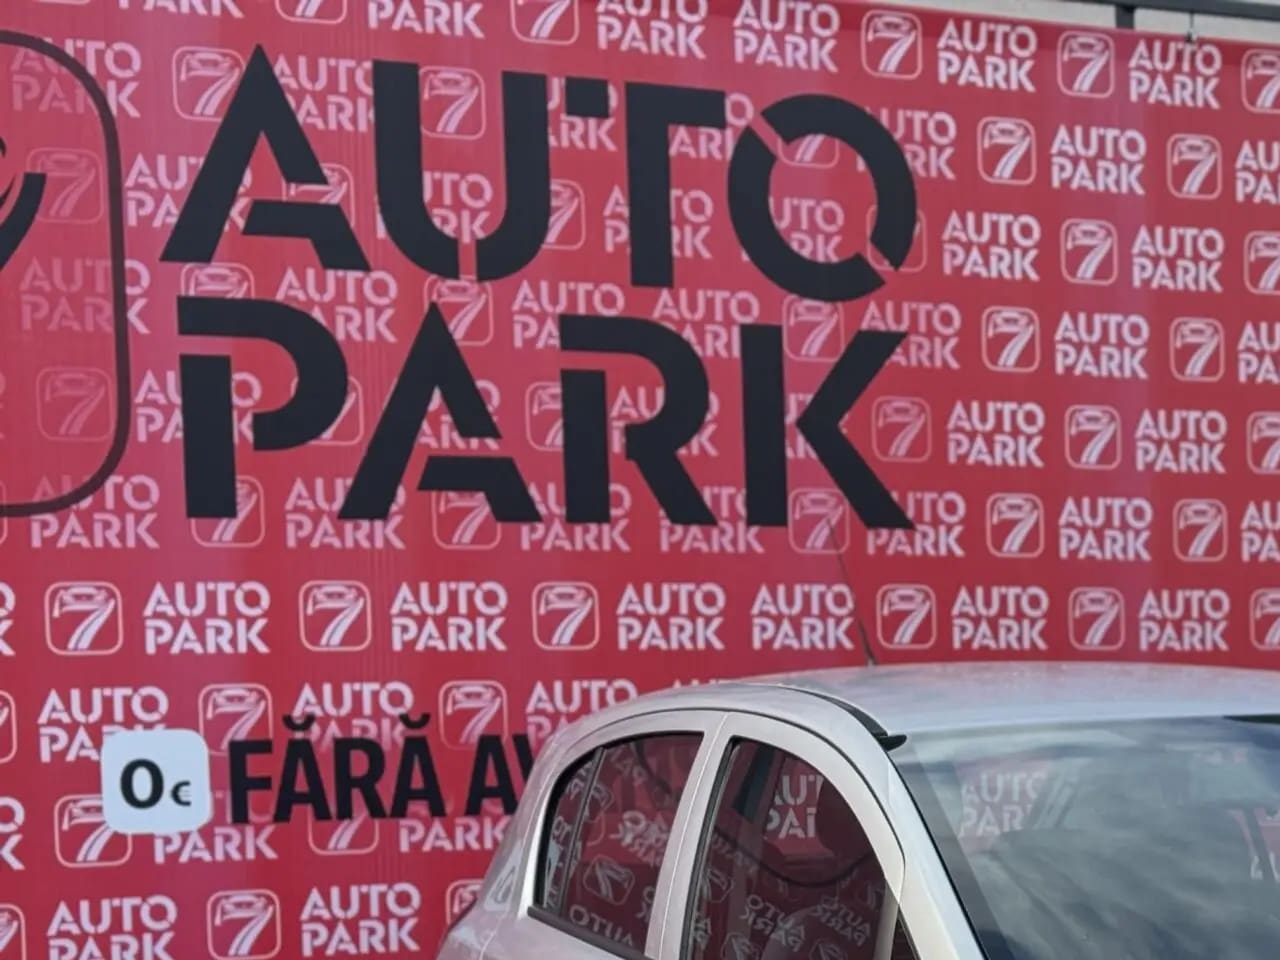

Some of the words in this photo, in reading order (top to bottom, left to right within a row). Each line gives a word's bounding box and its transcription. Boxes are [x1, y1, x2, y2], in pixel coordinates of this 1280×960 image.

[597, 15, 706, 60] PARK
[734, 0, 839, 38] AUTO
[937, 17, 1037, 58] AUTO
[734, 28, 837, 72] PARK
[1129, 40, 1221, 76] AUTO
[938, 50, 1035, 92] PARK
[1129, 70, 1219, 109] PARK
[1051, 125, 1146, 162] AUTO
[161, 44, 918, 303] AUTO
[1052, 155, 1145, 195] PARK
[943, 211, 1041, 247] AUTO
[1131, 226, 1224, 261] AUTO
[943, 243, 1038, 281] PARK
[1132, 255, 1222, 292] PARK
[275, 266, 398, 305] AUTO
[511, 280, 626, 317] AUTO
[652, 287, 760, 324] AUTO
[859, 300, 963, 336] AUTO
[1055, 312, 1150, 347] AUTO
[1055, 342, 1148, 379] PARK
[177, 296, 914, 530] PARK
[948, 401, 1045, 435] AUTO
[1135, 409, 1227, 441] AUTO
[948, 432, 1044, 467] PARK
[1136, 440, 1225, 473] PARK
[30, 511, 160, 549] PARK
[285, 512, 406, 550] PARK
[1059, 497, 1153, 529] AUTO
[520, 517, 631, 552] PARK
[866, 523, 966, 558] PARK
[1059, 528, 1150, 561] PARK
[144, 581, 270, 618] AUTO
[390, 581, 508, 617] AUTO
[617, 583, 725, 617] AUTO
[751, 583, 855, 617] AUTO
[952, 586, 1049, 618] AUTO
[1138, 589, 1230, 621] AUTO
[145, 617, 268, 655] PARK
[392, 615, 506, 651] PARK
[618, 615, 724, 650] PARK
[752, 616, 853, 650] PARK
[952, 617, 1046, 650] PARK
[1139, 619, 1228, 651] PARK
[37, 685, 169, 725] AUTO
[292, 681, 414, 719] AUTO
[525, 679, 639, 714] AUTO
[229, 713, 447, 826] FĂRĂ
[154, 824, 279, 864] PARK
[47, 895, 177, 937] AUTO
[301, 882, 421, 921] AUTO
[302, 917, 419, 957] PARK
